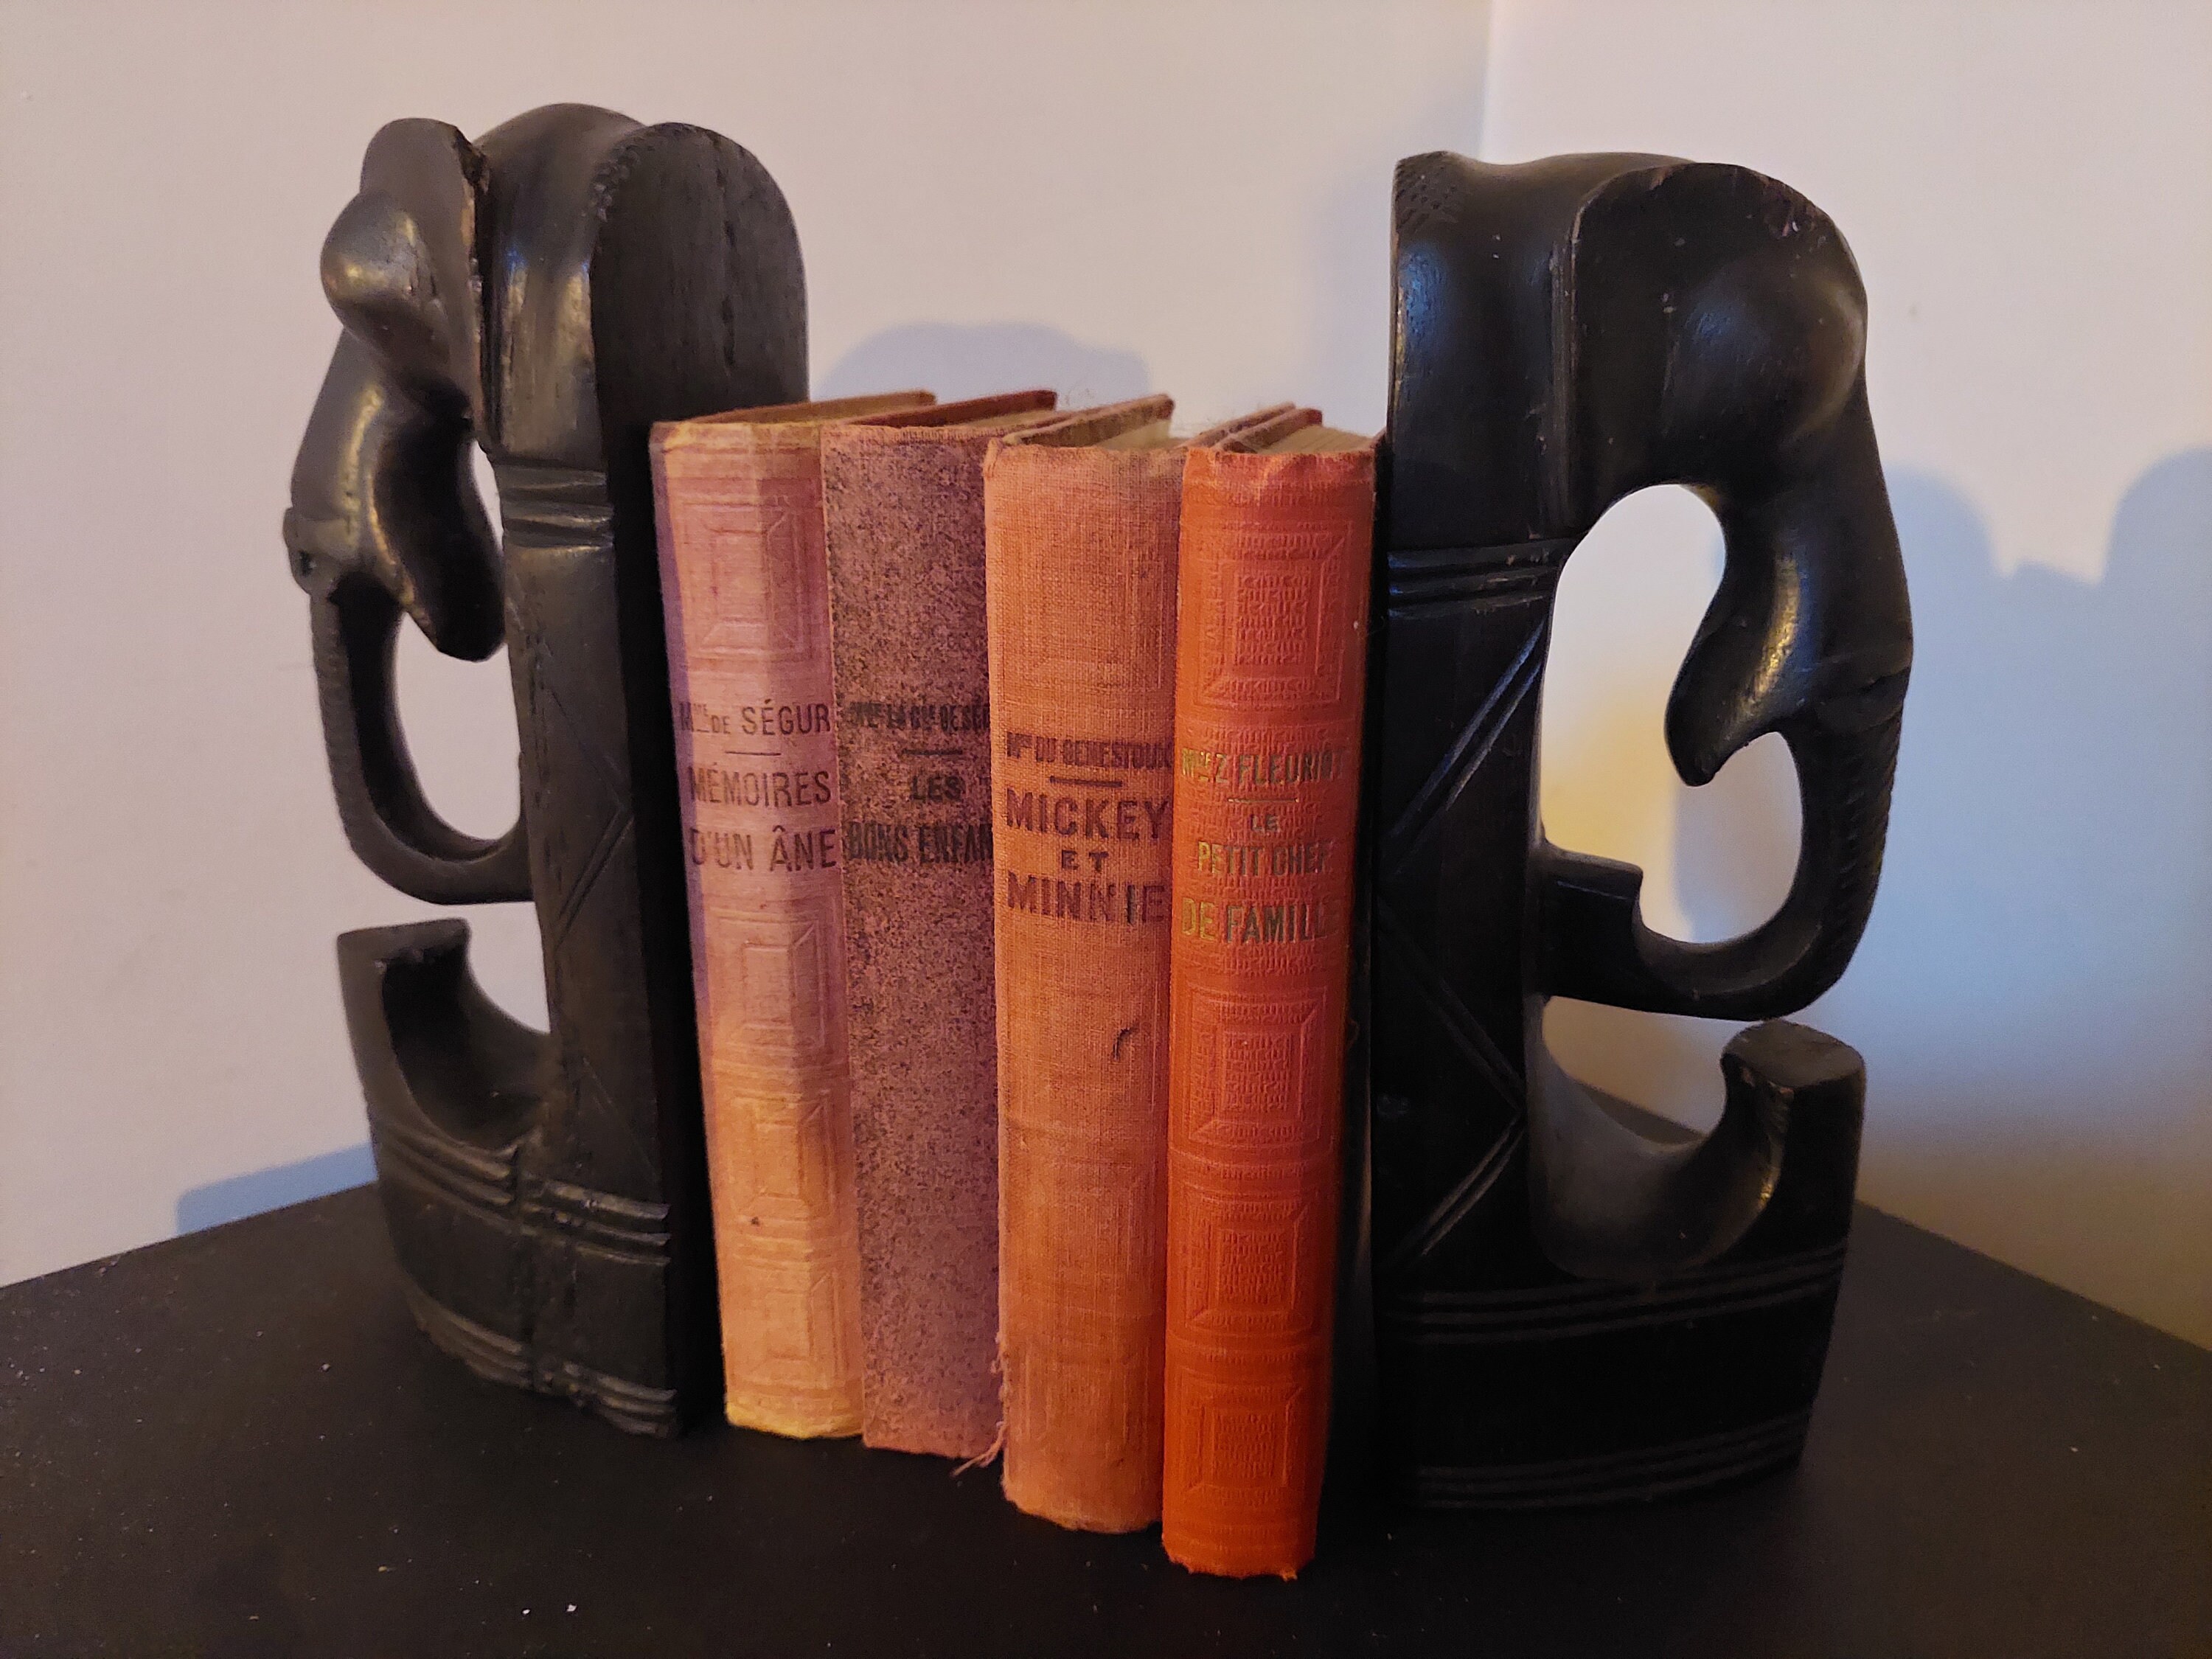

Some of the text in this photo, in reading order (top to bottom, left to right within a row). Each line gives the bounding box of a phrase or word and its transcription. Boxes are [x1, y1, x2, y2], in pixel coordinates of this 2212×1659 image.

[711, 714, 731, 735] DE
[741, 698, 832, 736] SÉGUR
[687, 762, 832, 807] MÉMOIRES
[911, 773, 965, 801] LES
[1006, 788, 1170, 840] MICKEY
[1251, 813, 1282, 834] LE
[689, 824, 837, 872] D'UN ÂNE
[848, 821, 909, 862] BONS
[1061, 849, 1110, 873] ET
[1197, 840, 1266, 877] PETIT
[1007, 870, 1166, 925] MINNIE
[1182, 897, 1217, 942] DE
